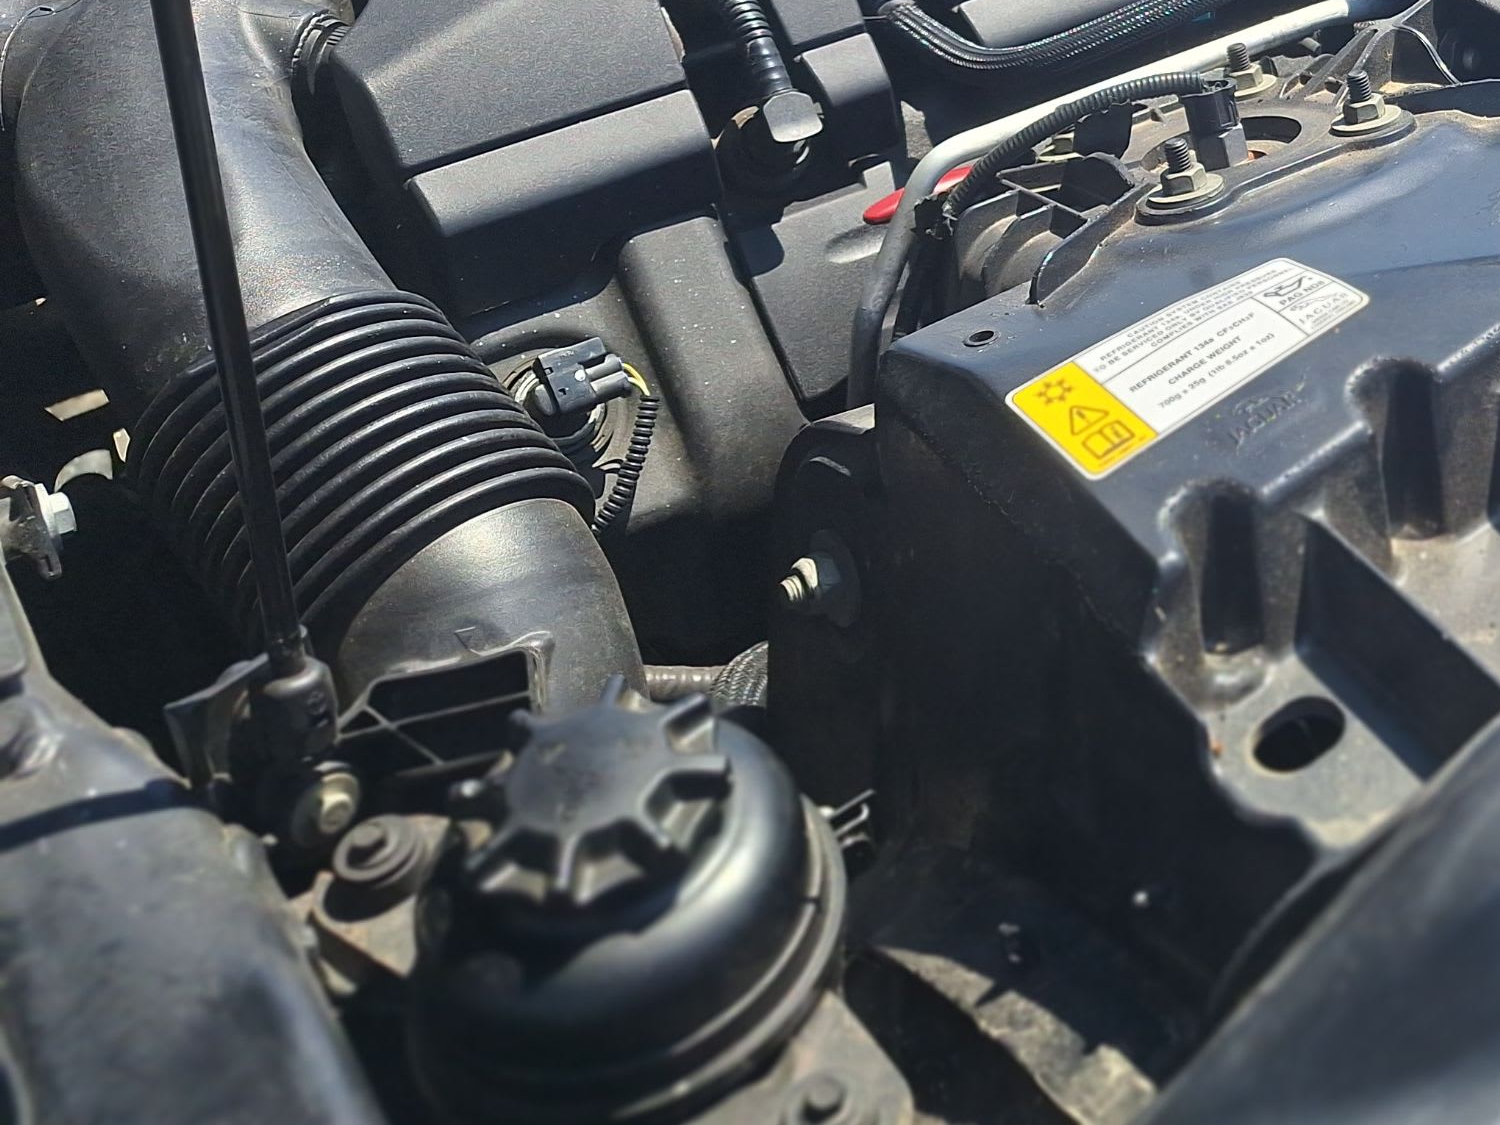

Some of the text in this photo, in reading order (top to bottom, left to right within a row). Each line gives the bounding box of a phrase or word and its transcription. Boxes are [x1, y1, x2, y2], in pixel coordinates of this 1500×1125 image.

[1093, 267, 1293, 373] TO BE SERVICED ONLY BY QUALIFIED PERSONNEL
[1099, 325, 1158, 361] REFRIGERANT
[1183, 299, 1212, 314] UNDER
[1212, 289, 1234, 300] HIGH
[1234, 269, 1277, 292] PRESSURE
[1126, 280, 1241, 338] CAUTION SYSTEM CONTAINS
[1150, 321, 1193, 347] COMPLIES
[1193, 309, 1216, 322] WITH
[1216, 300, 1234, 310] SAE
[1278, 292, 1303, 306] PAG
[1298, 292, 1348, 324] JAGUAR
[1129, 349, 1192, 392] REFRIGERANT
[1193, 337, 1215, 351] 134a
[1158, 392, 1182, 408] 700g
[1187, 377, 1207, 390] 25g
[1255, 332, 1275, 345] 1oz)
[1167, 335, 1241, 385] CHARGE WEIGHT
